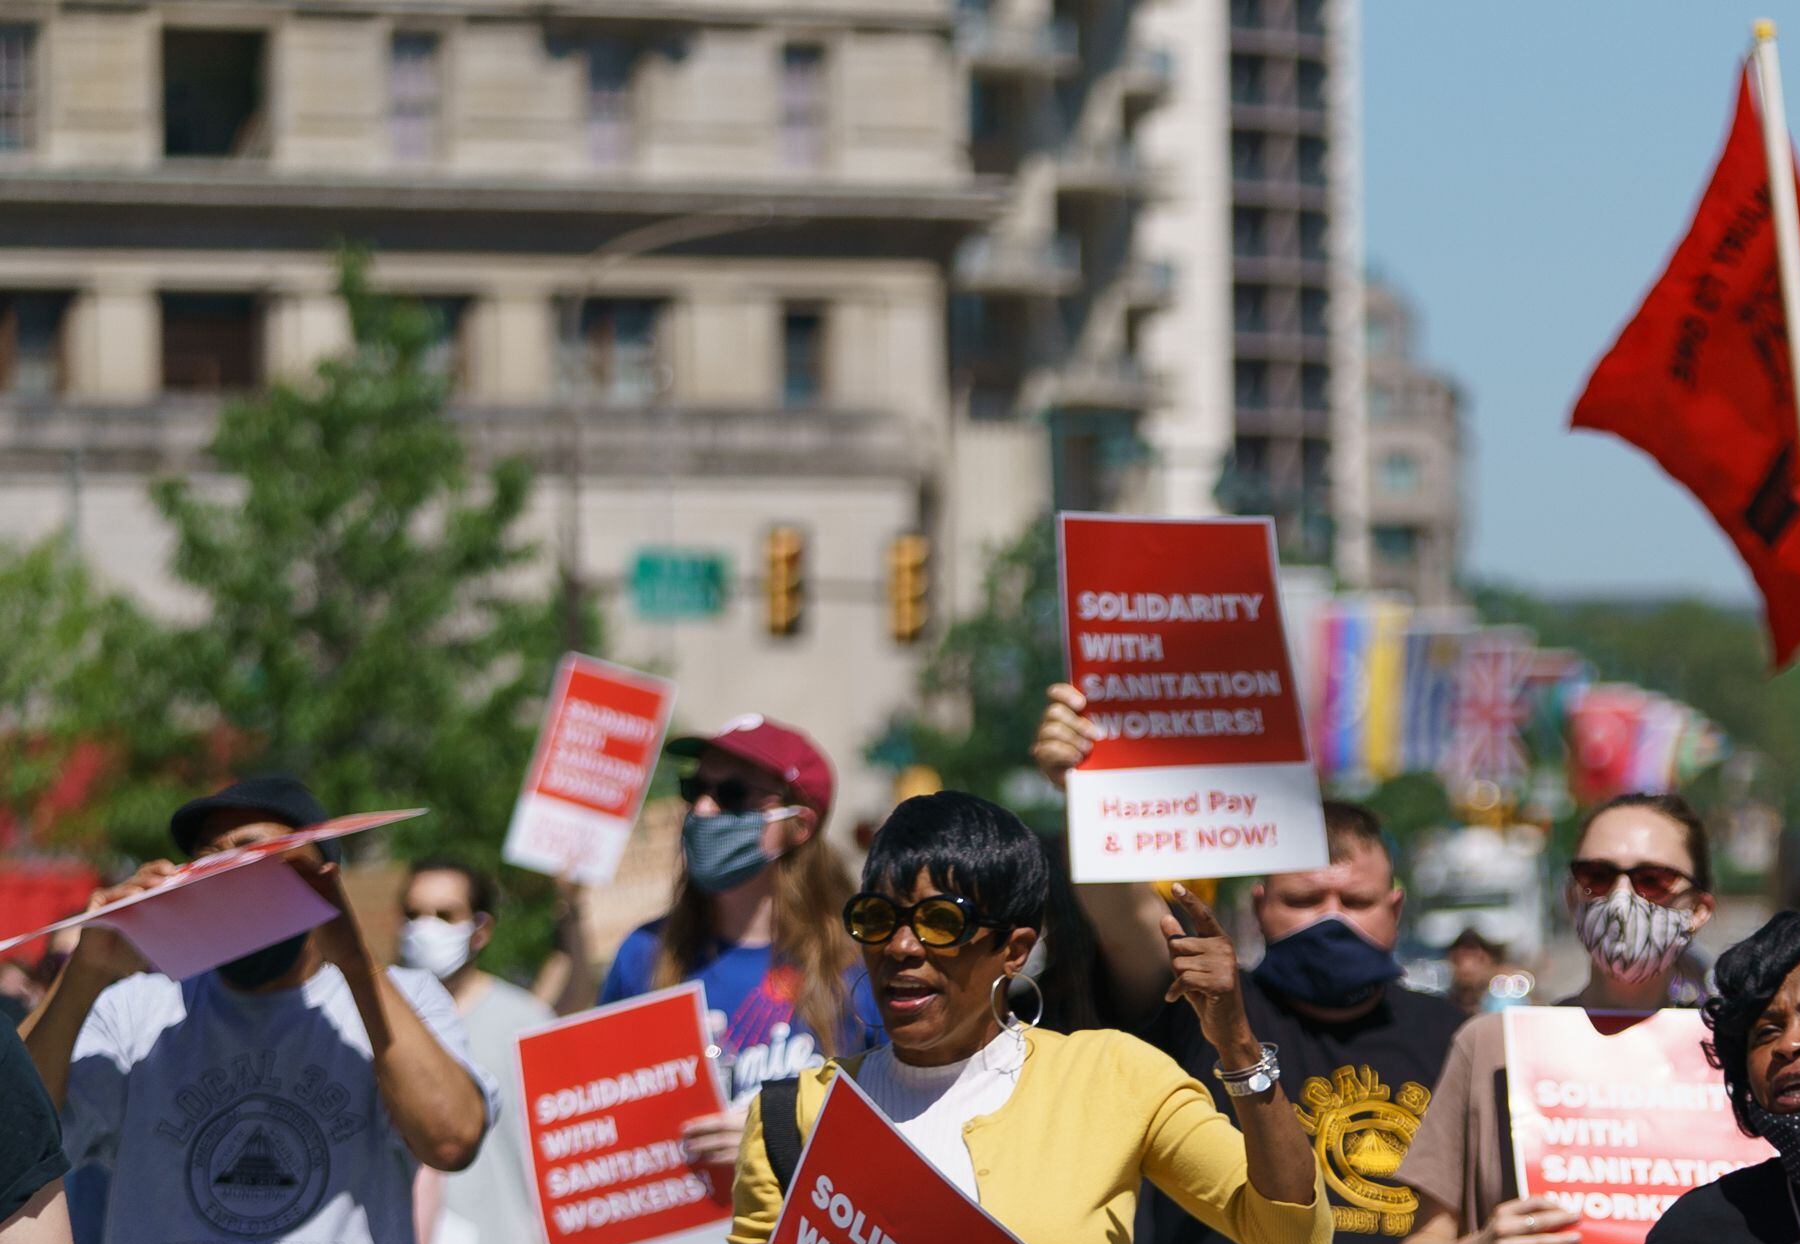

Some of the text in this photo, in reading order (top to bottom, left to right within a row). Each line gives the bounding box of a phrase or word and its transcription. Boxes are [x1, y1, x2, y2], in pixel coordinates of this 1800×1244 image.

[1078, 591, 1264, 622] SOLIDARITY
[1080, 631, 1164, 661] WITH
[1081, 671, 1282, 700] SANITATION
[1090, 709, 1265, 739] WORKERS!
[1102, 790, 1258, 818] Hazard Pay
[1105, 822, 1278, 853] & PPE NOW!
[154, 1049, 282, 1147] LOCAL
[535, 1054, 700, 1125] SOLIDARITY
[1535, 1079, 1732, 1111] SOLIDARIT
[539, 1115, 618, 1161] WITH
[1543, 1116, 1638, 1147] WITH
[546, 1138, 692, 1199] SANITATI
[1540, 1155, 1752, 1186] SANITATIO
[1544, 1190, 1680, 1220] WORK
